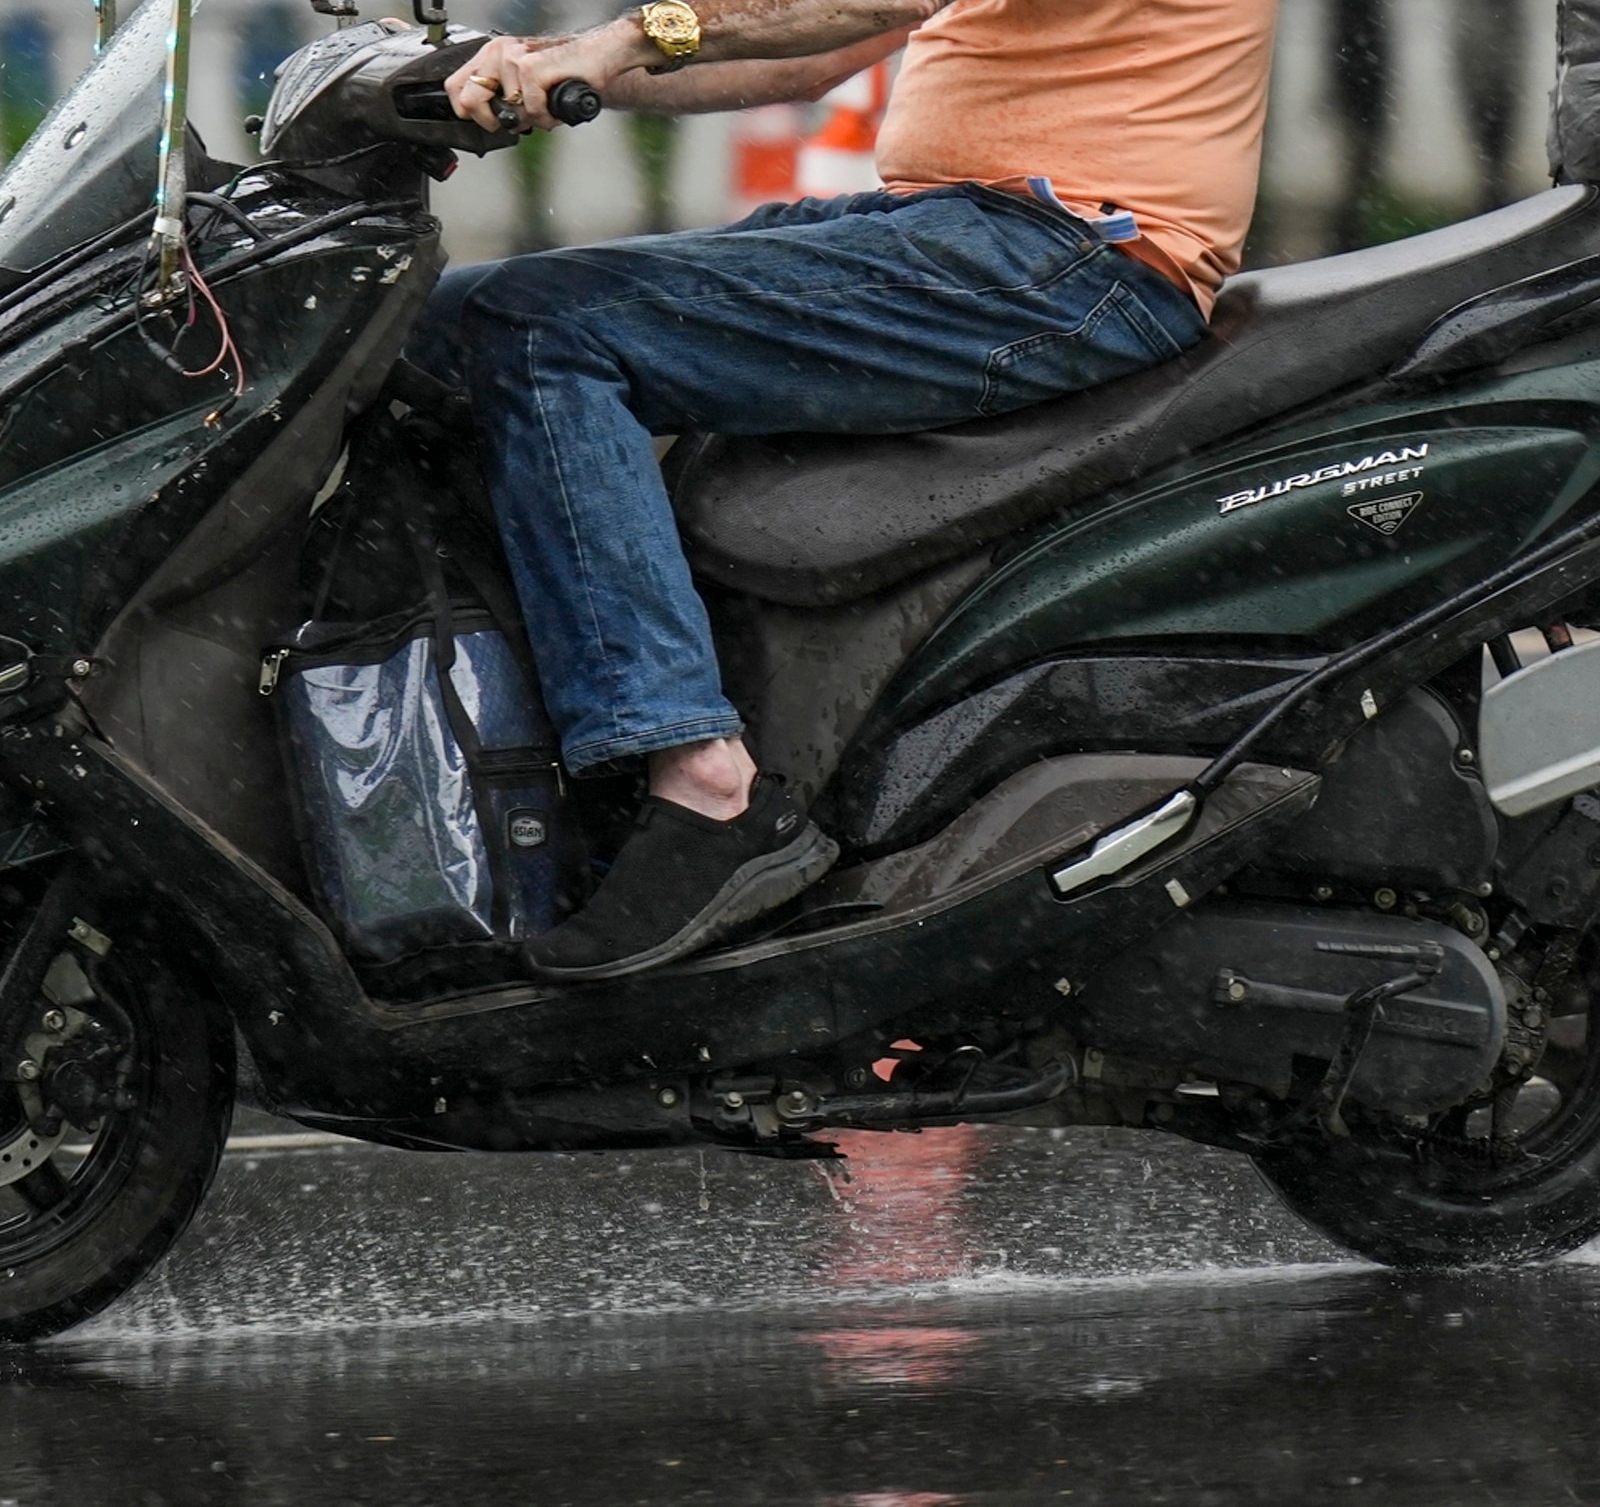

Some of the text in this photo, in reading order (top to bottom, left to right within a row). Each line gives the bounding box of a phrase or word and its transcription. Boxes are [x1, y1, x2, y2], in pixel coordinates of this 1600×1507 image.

[1216, 443, 1429, 515] BURGMAN
[1342, 466, 1425, 497] STREET
[1359, 497, 1414, 518] RIDE CONNECT
[1372, 510, 1403, 525] EDITION
